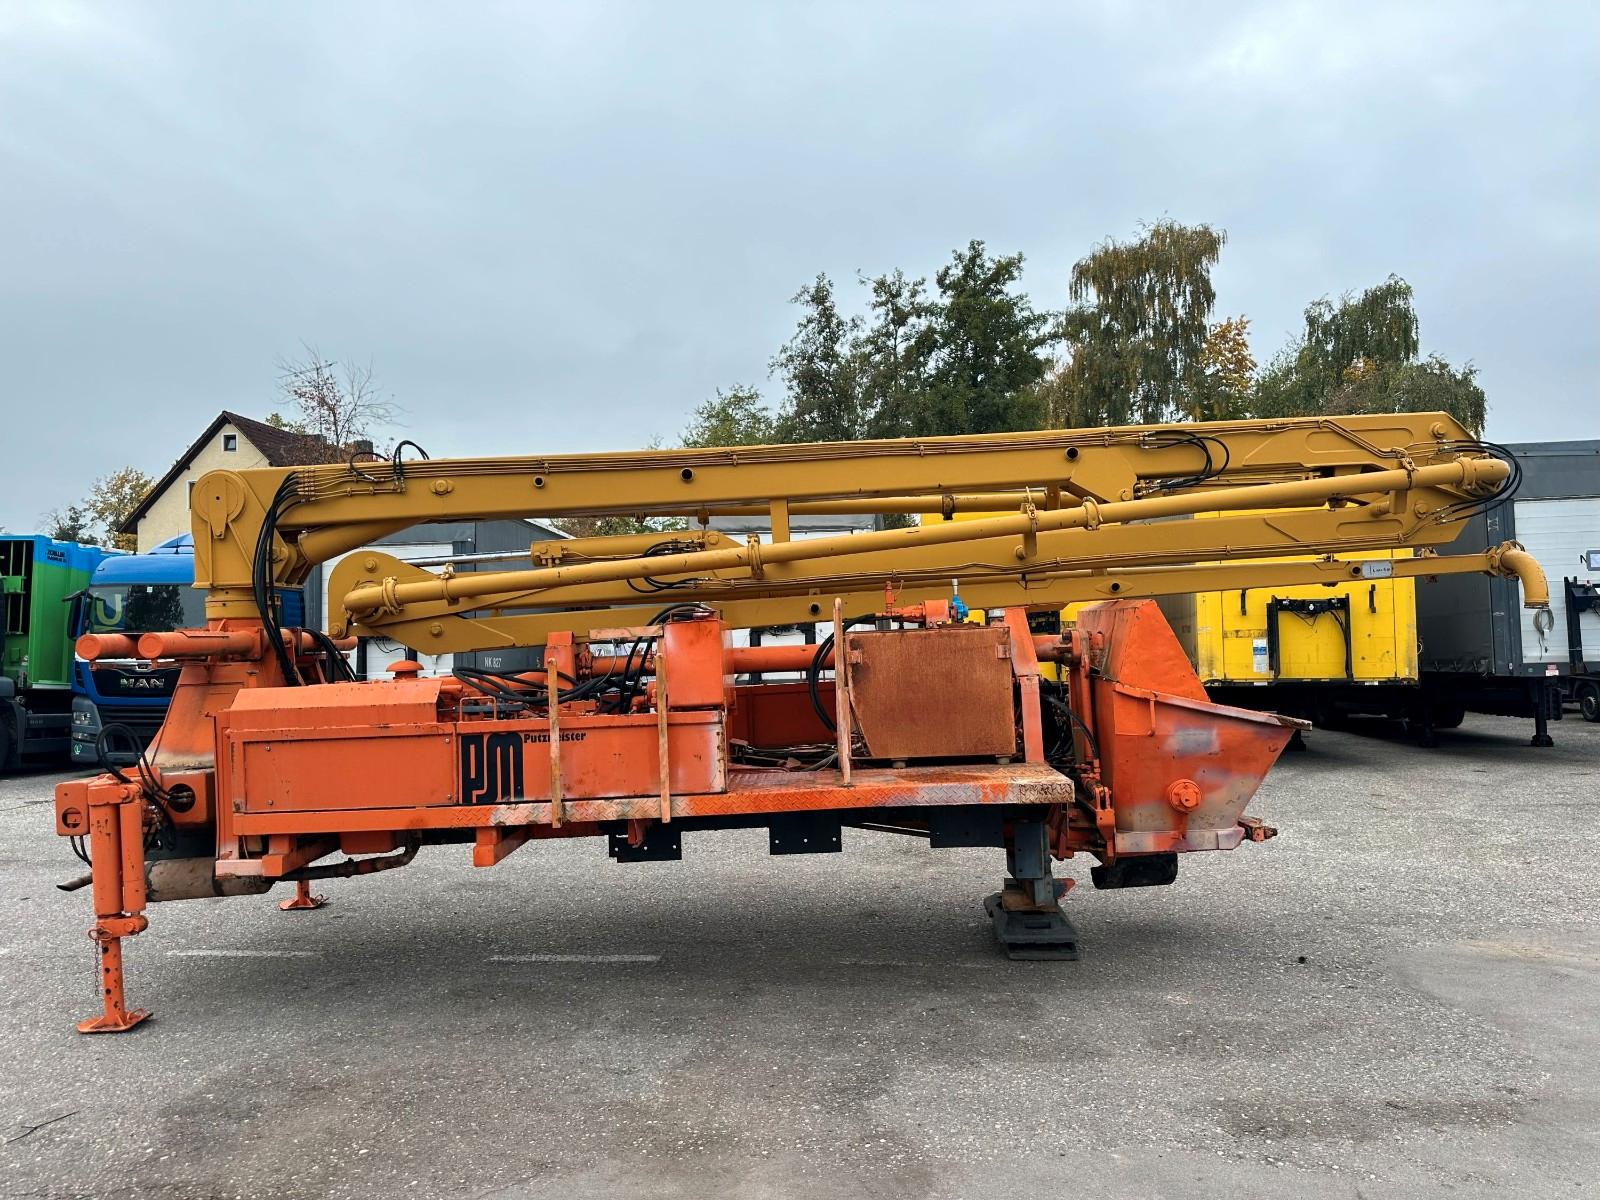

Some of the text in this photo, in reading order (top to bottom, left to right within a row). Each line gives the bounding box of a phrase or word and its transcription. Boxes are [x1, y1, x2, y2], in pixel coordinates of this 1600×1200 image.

[484, 656, 493, 668] NK
[120, 678, 165, 689] MAN
[523, 731, 587, 743] Putzeister
